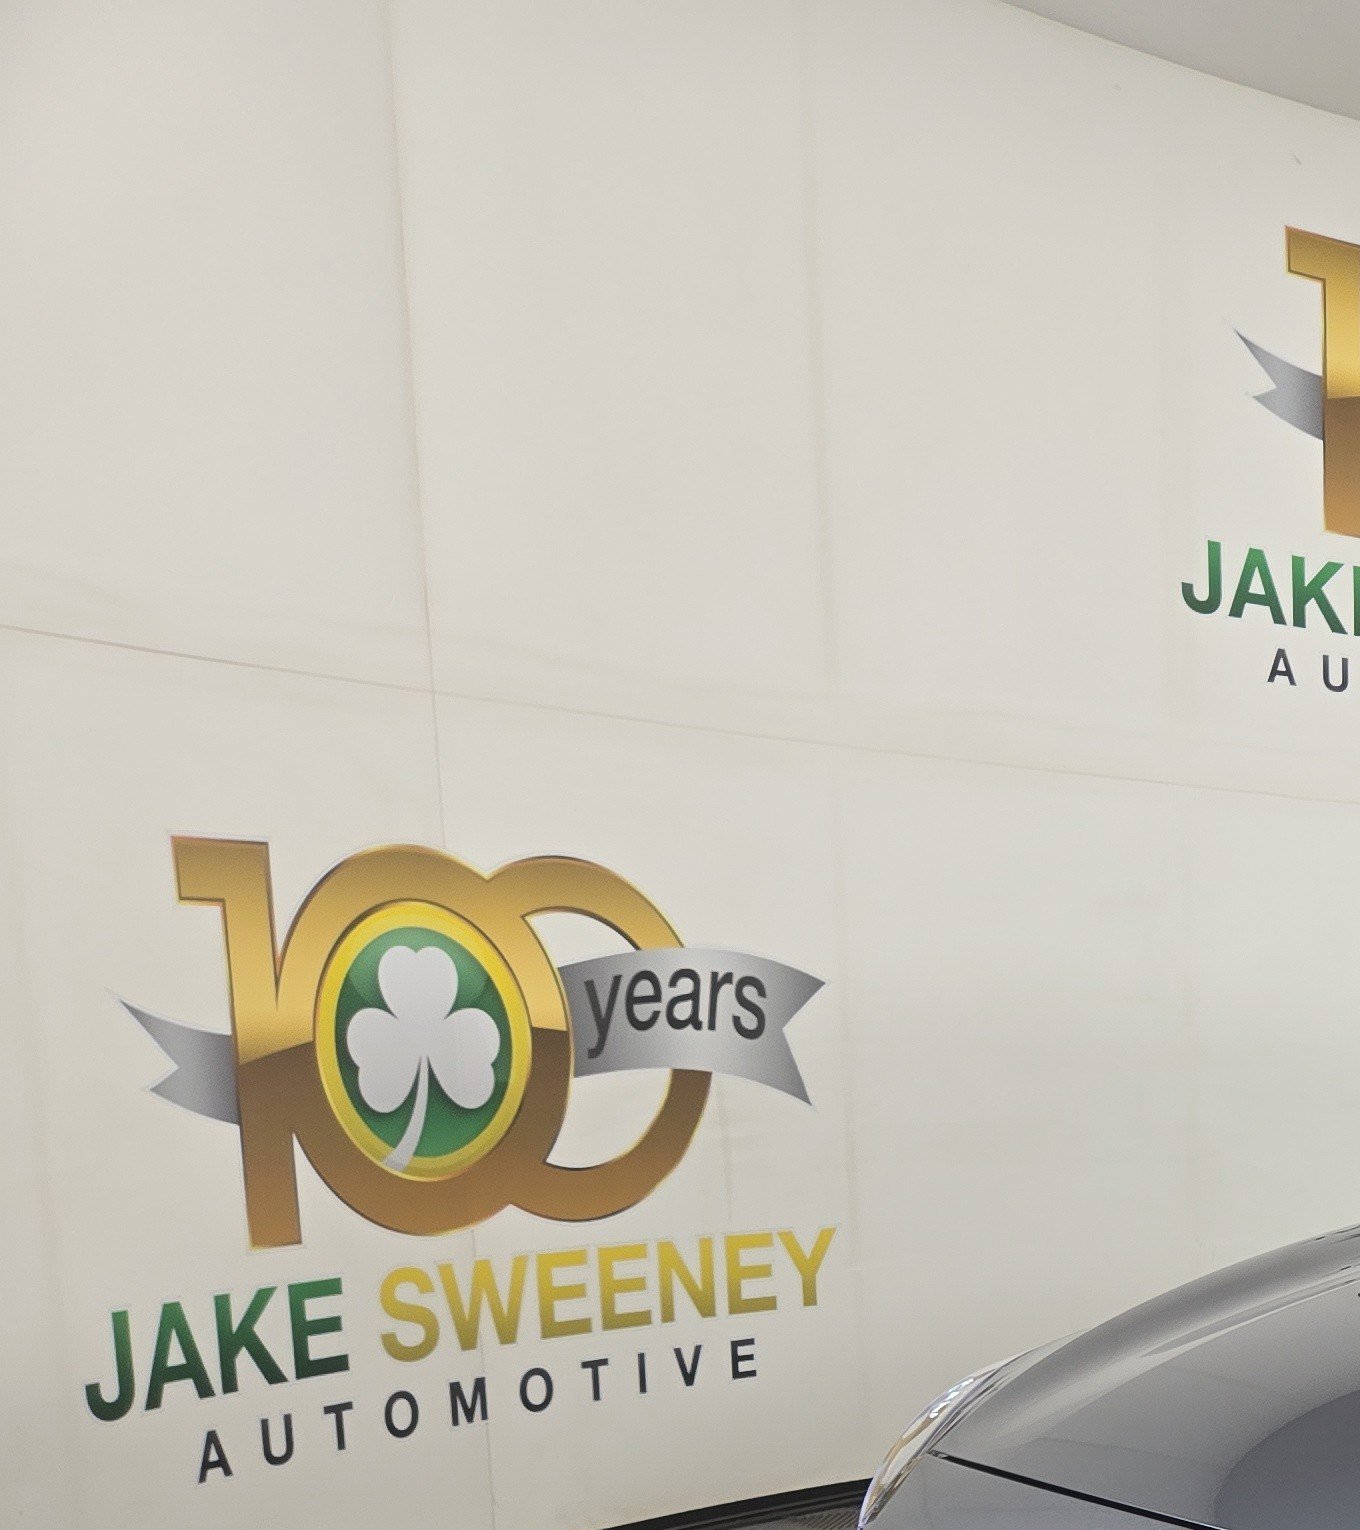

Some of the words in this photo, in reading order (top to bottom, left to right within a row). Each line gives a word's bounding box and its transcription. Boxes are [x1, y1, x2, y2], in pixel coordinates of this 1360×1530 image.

[171, 836, 712, 1250] 100
[583, 967, 767, 1058] years
[85, 1277, 350, 1422] JAKE
[378, 1227, 837, 1362] SWEENEY
[197, 1337, 757, 1483] AUTOMOTIVE
